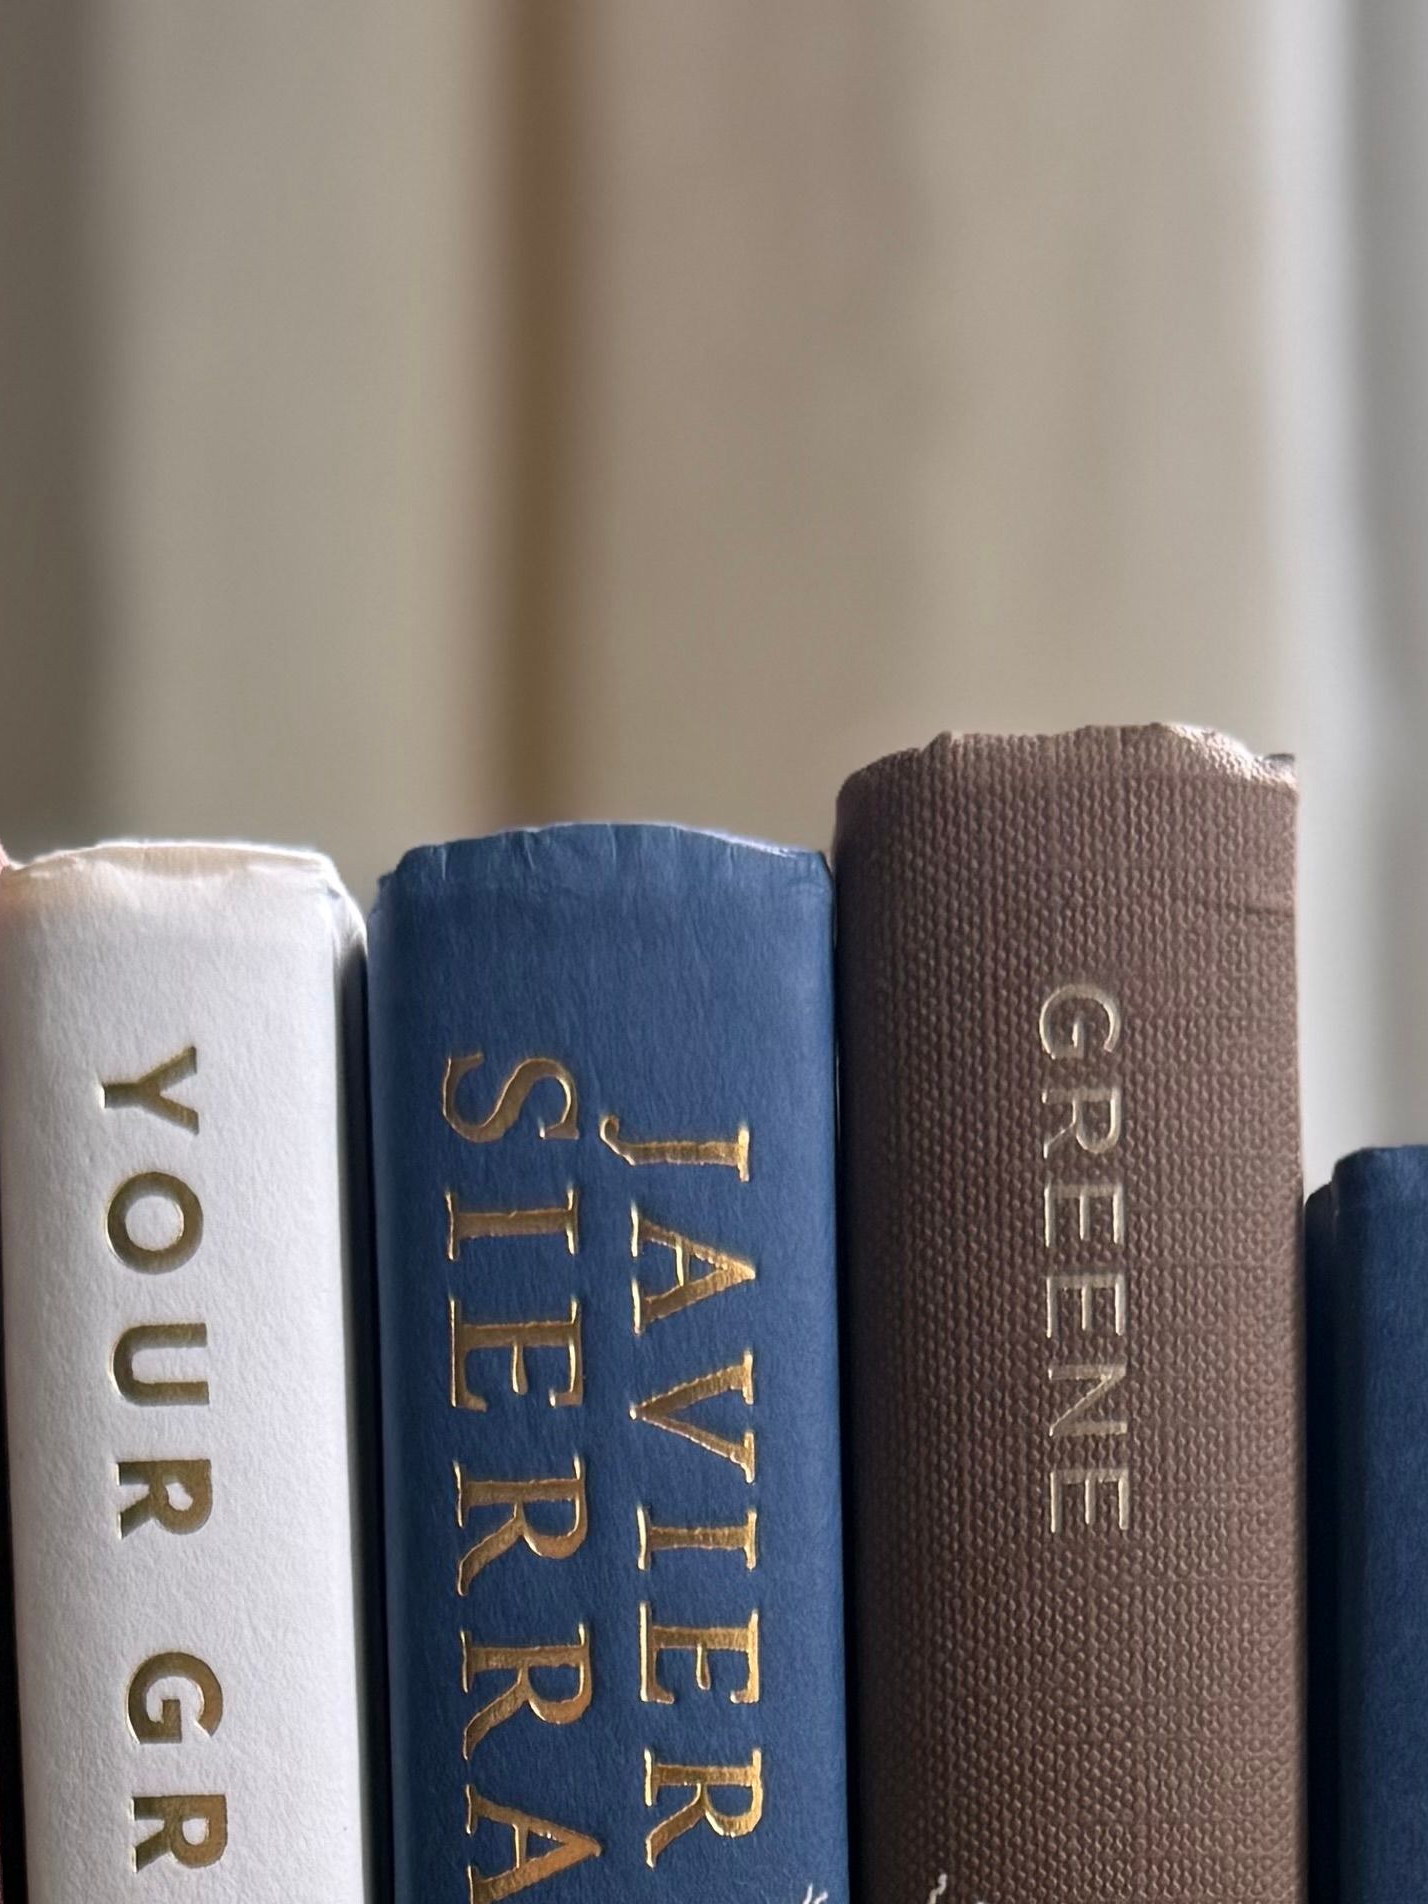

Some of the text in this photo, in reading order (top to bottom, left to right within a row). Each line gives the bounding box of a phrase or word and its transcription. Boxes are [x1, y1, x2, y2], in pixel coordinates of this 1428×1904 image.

[102, 1044, 217, 1542] YOUR
[599, 1112, 765, 1870] JAVIER
[1038, 984, 1130, 1536] GREENE
